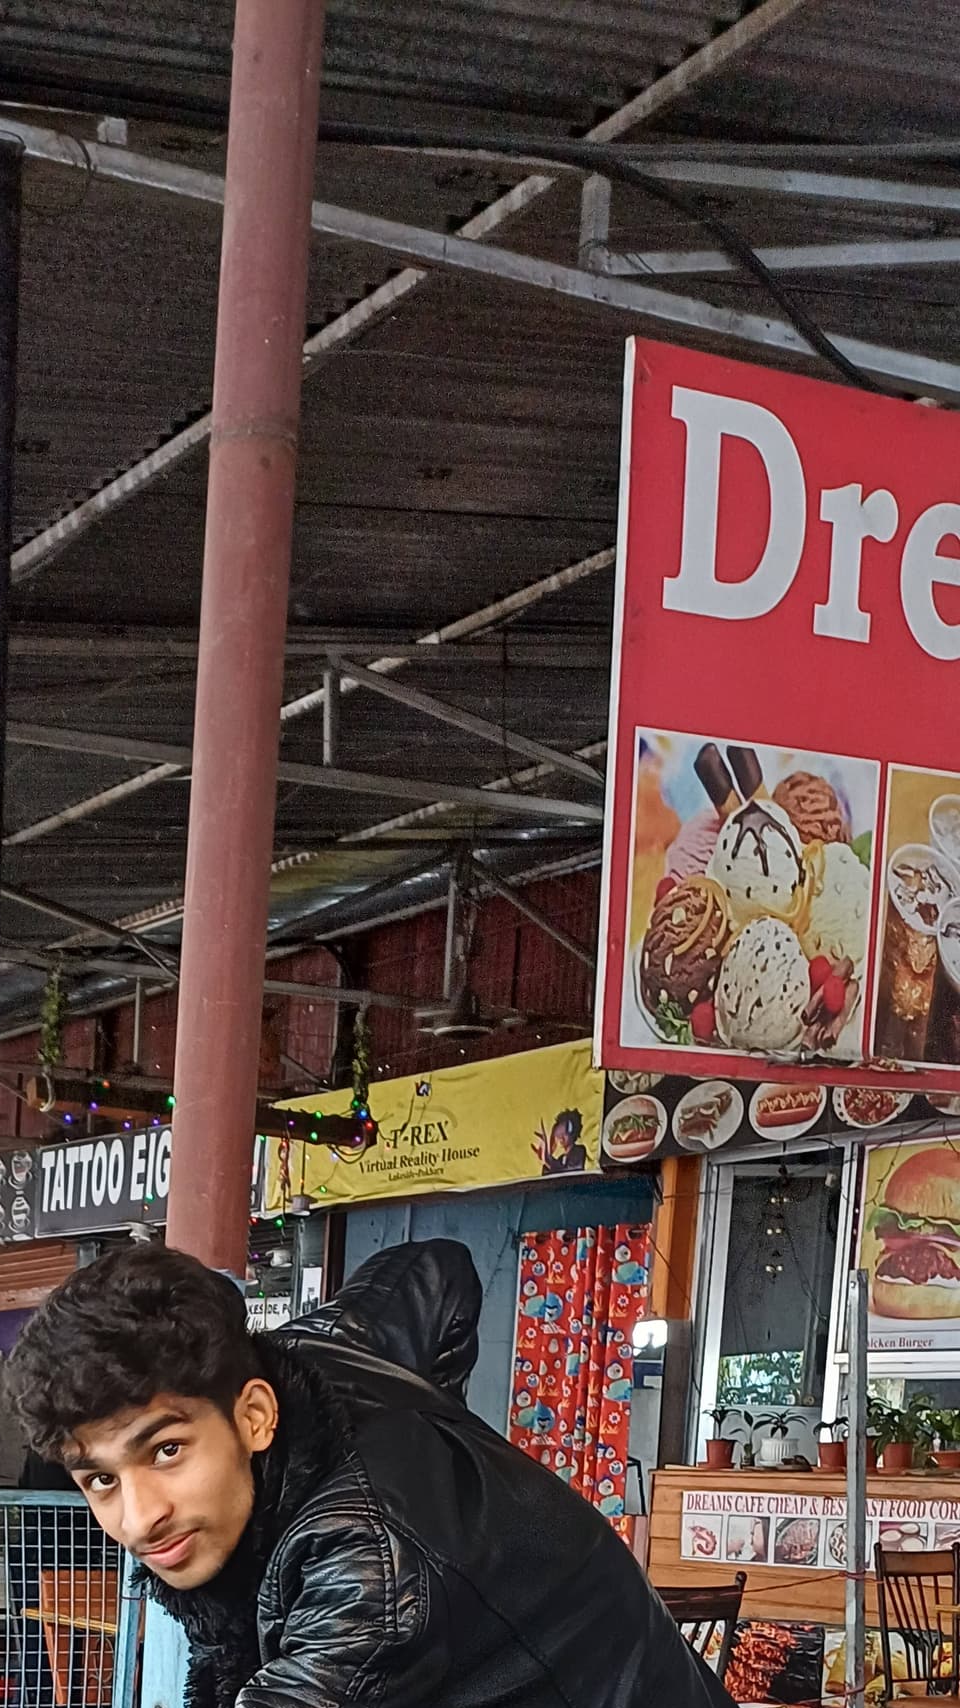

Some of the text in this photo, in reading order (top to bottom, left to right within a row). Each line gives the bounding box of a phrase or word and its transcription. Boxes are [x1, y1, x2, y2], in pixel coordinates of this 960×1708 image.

[662, 384, 960, 661] Dre
[390, 1120, 449, 1149] T-REX
[41, 1138, 125, 1213] TATTOO
[130, 1129, 173, 1201] EIG
[358, 1146, 481, 1174] Virtual Reality House
[898, 1336, 935, 1350] Burger
[686, 1493, 733, 1512] DREAMS
[734, 1495, 765, 1513] CAFE
[767, 1496, 808, 1515] CHEAP
[822, 1497, 848, 1516] BES
[889, 1500, 927, 1518] FOOD
[929, 1501, 960, 1520] COR
